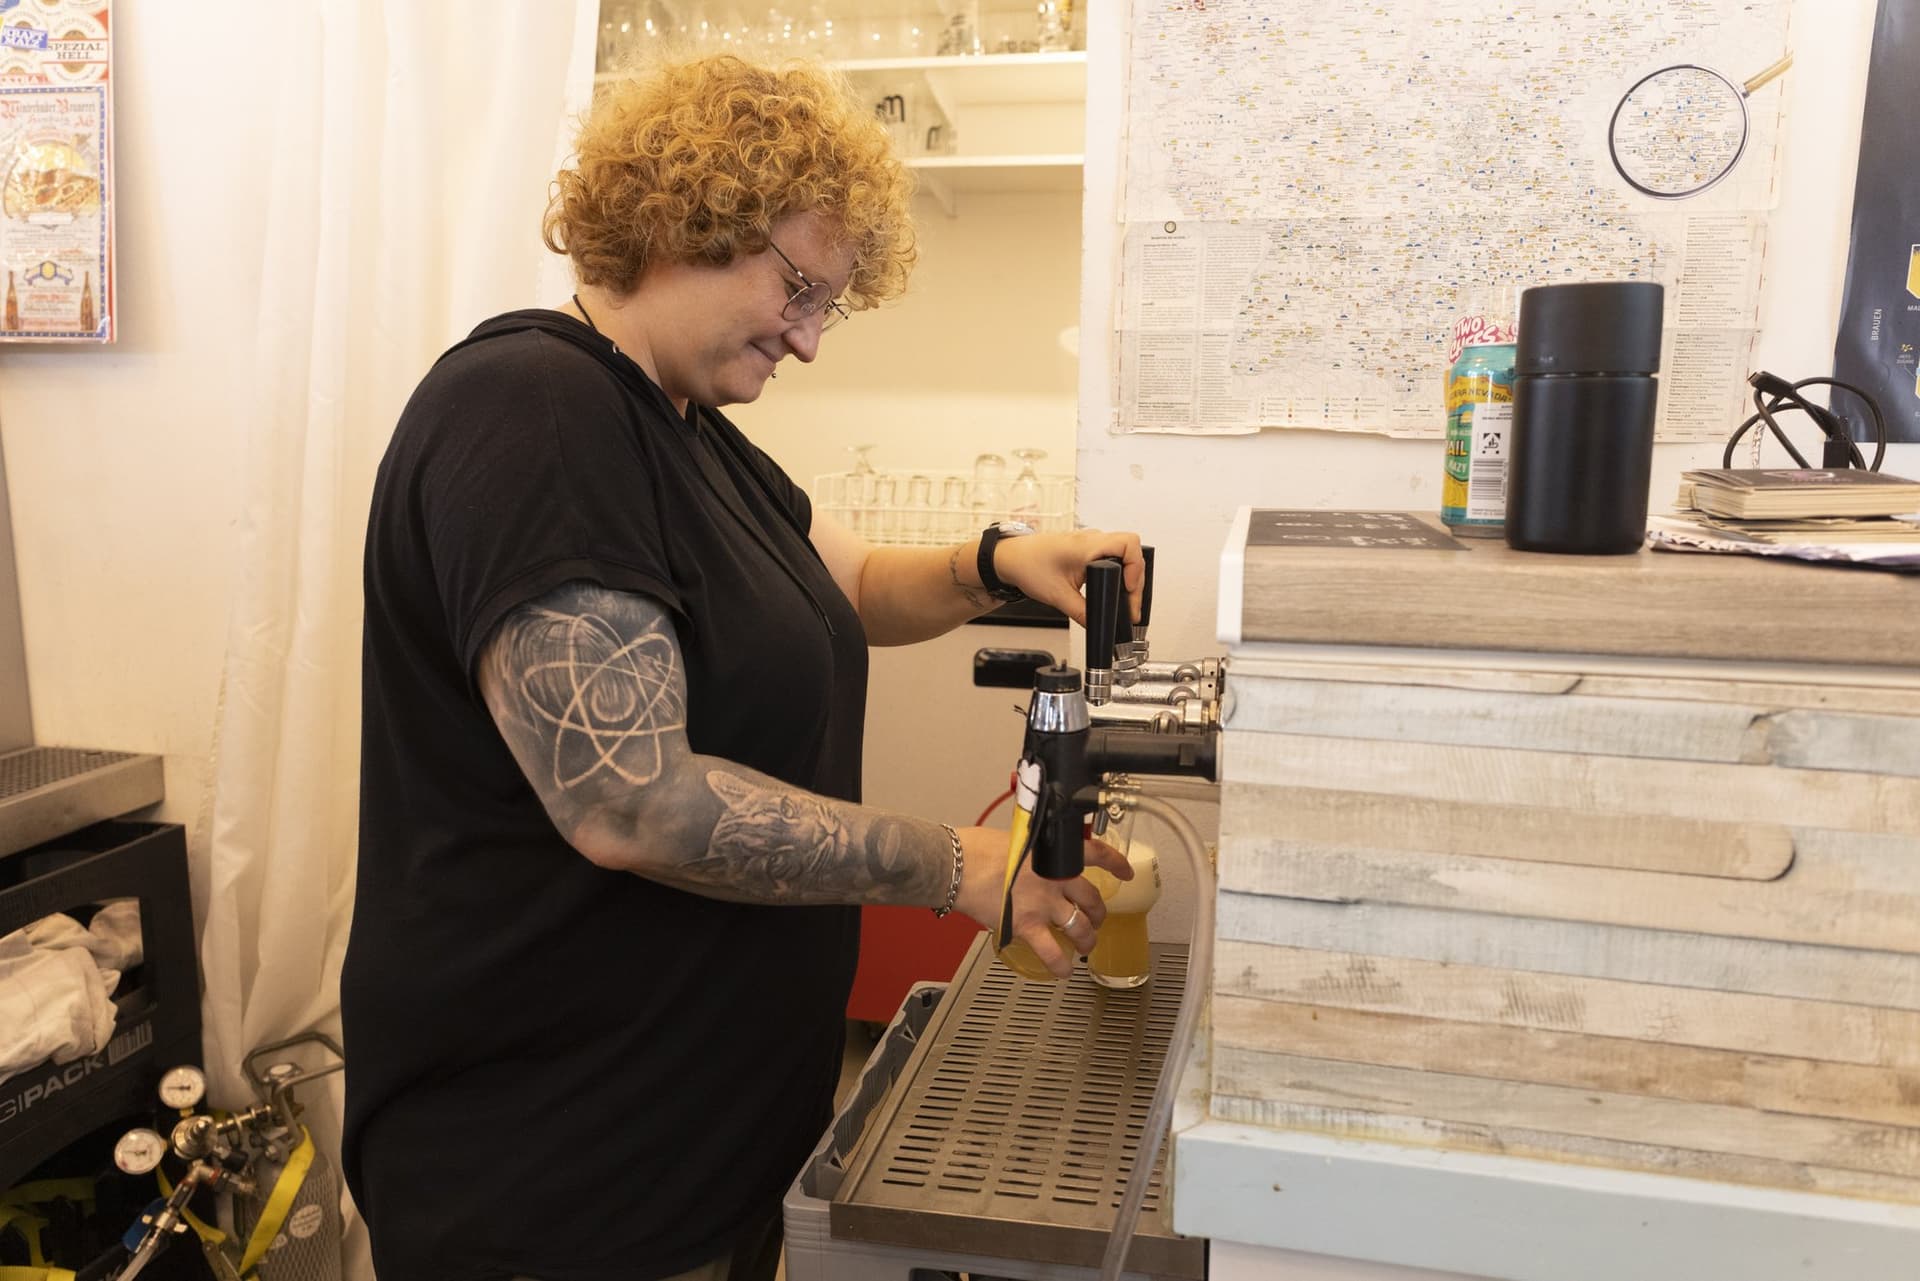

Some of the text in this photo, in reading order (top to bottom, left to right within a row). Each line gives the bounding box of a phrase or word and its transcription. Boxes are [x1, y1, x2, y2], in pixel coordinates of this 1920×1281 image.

[57, 52, 92, 60] HELL
[1454, 316, 1484, 338] TWO
[1871, 308, 1882, 341] BRAUEN
